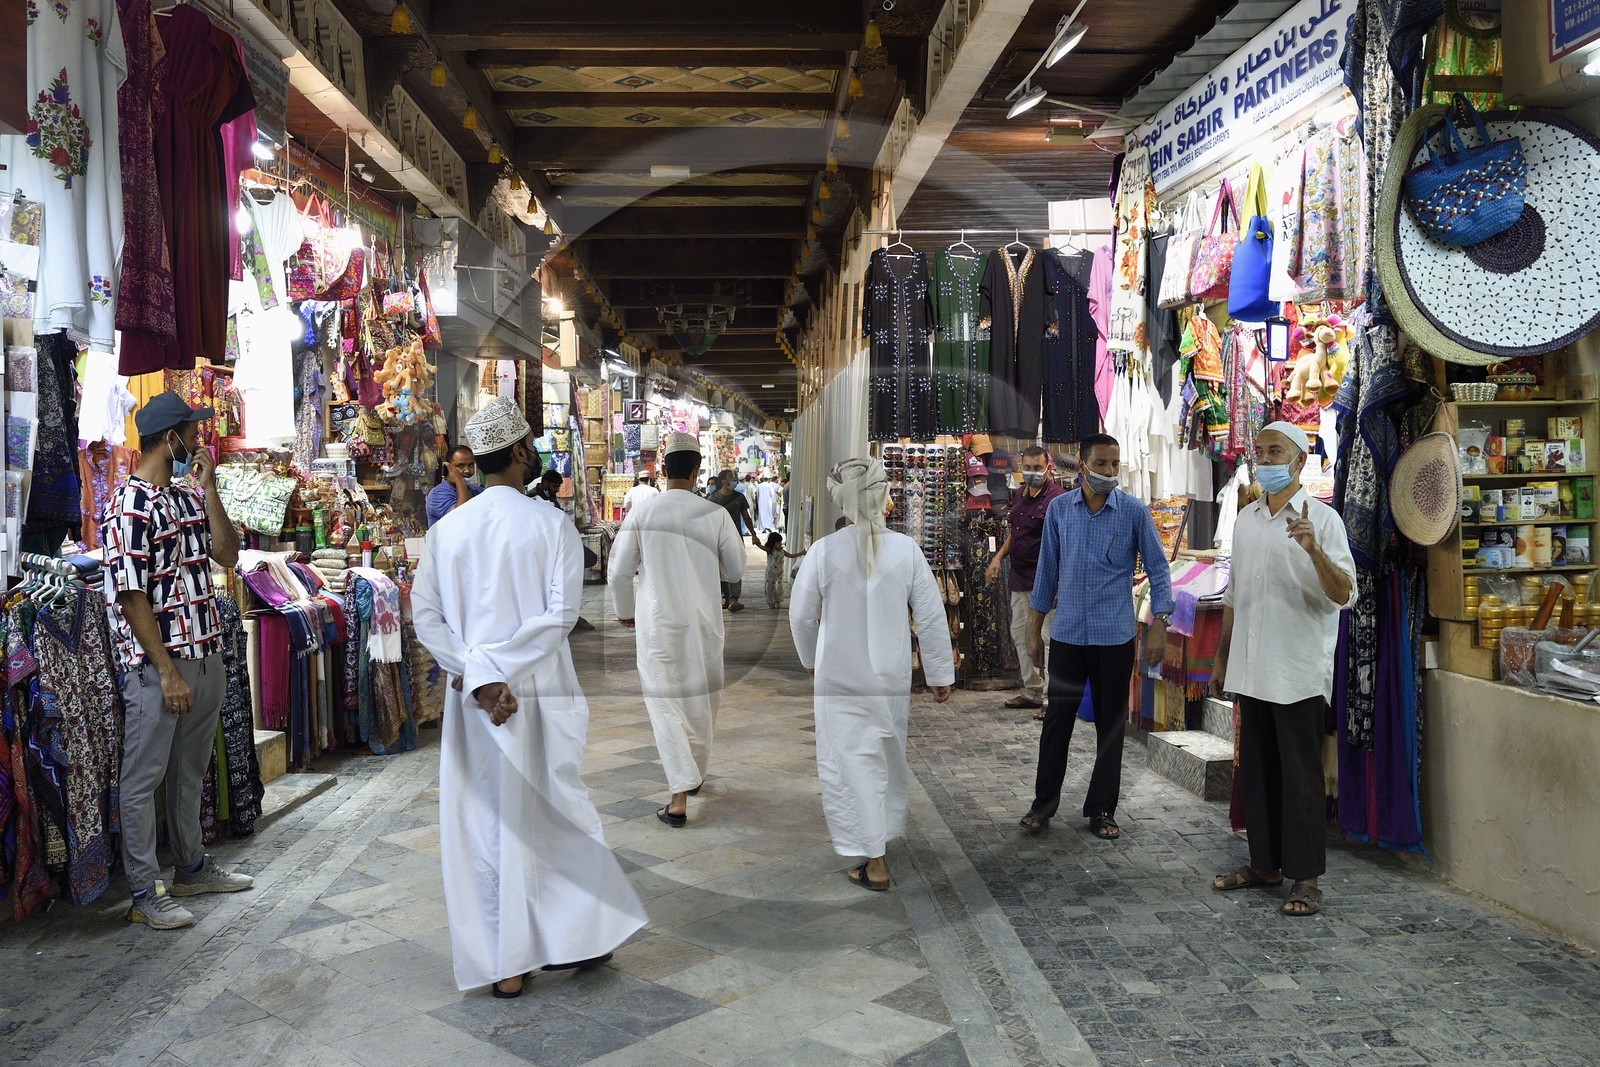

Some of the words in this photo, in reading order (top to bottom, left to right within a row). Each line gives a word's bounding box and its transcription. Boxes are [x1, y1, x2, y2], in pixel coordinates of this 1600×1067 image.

[1274, 25, 1297, 58] بن
[1235, 47, 1272, 88] صابر
[1151, 141, 1172, 173] BIN
[1177, 107, 1224, 155] SABIR
[1234, 29, 1338, 119] PARTNERS
